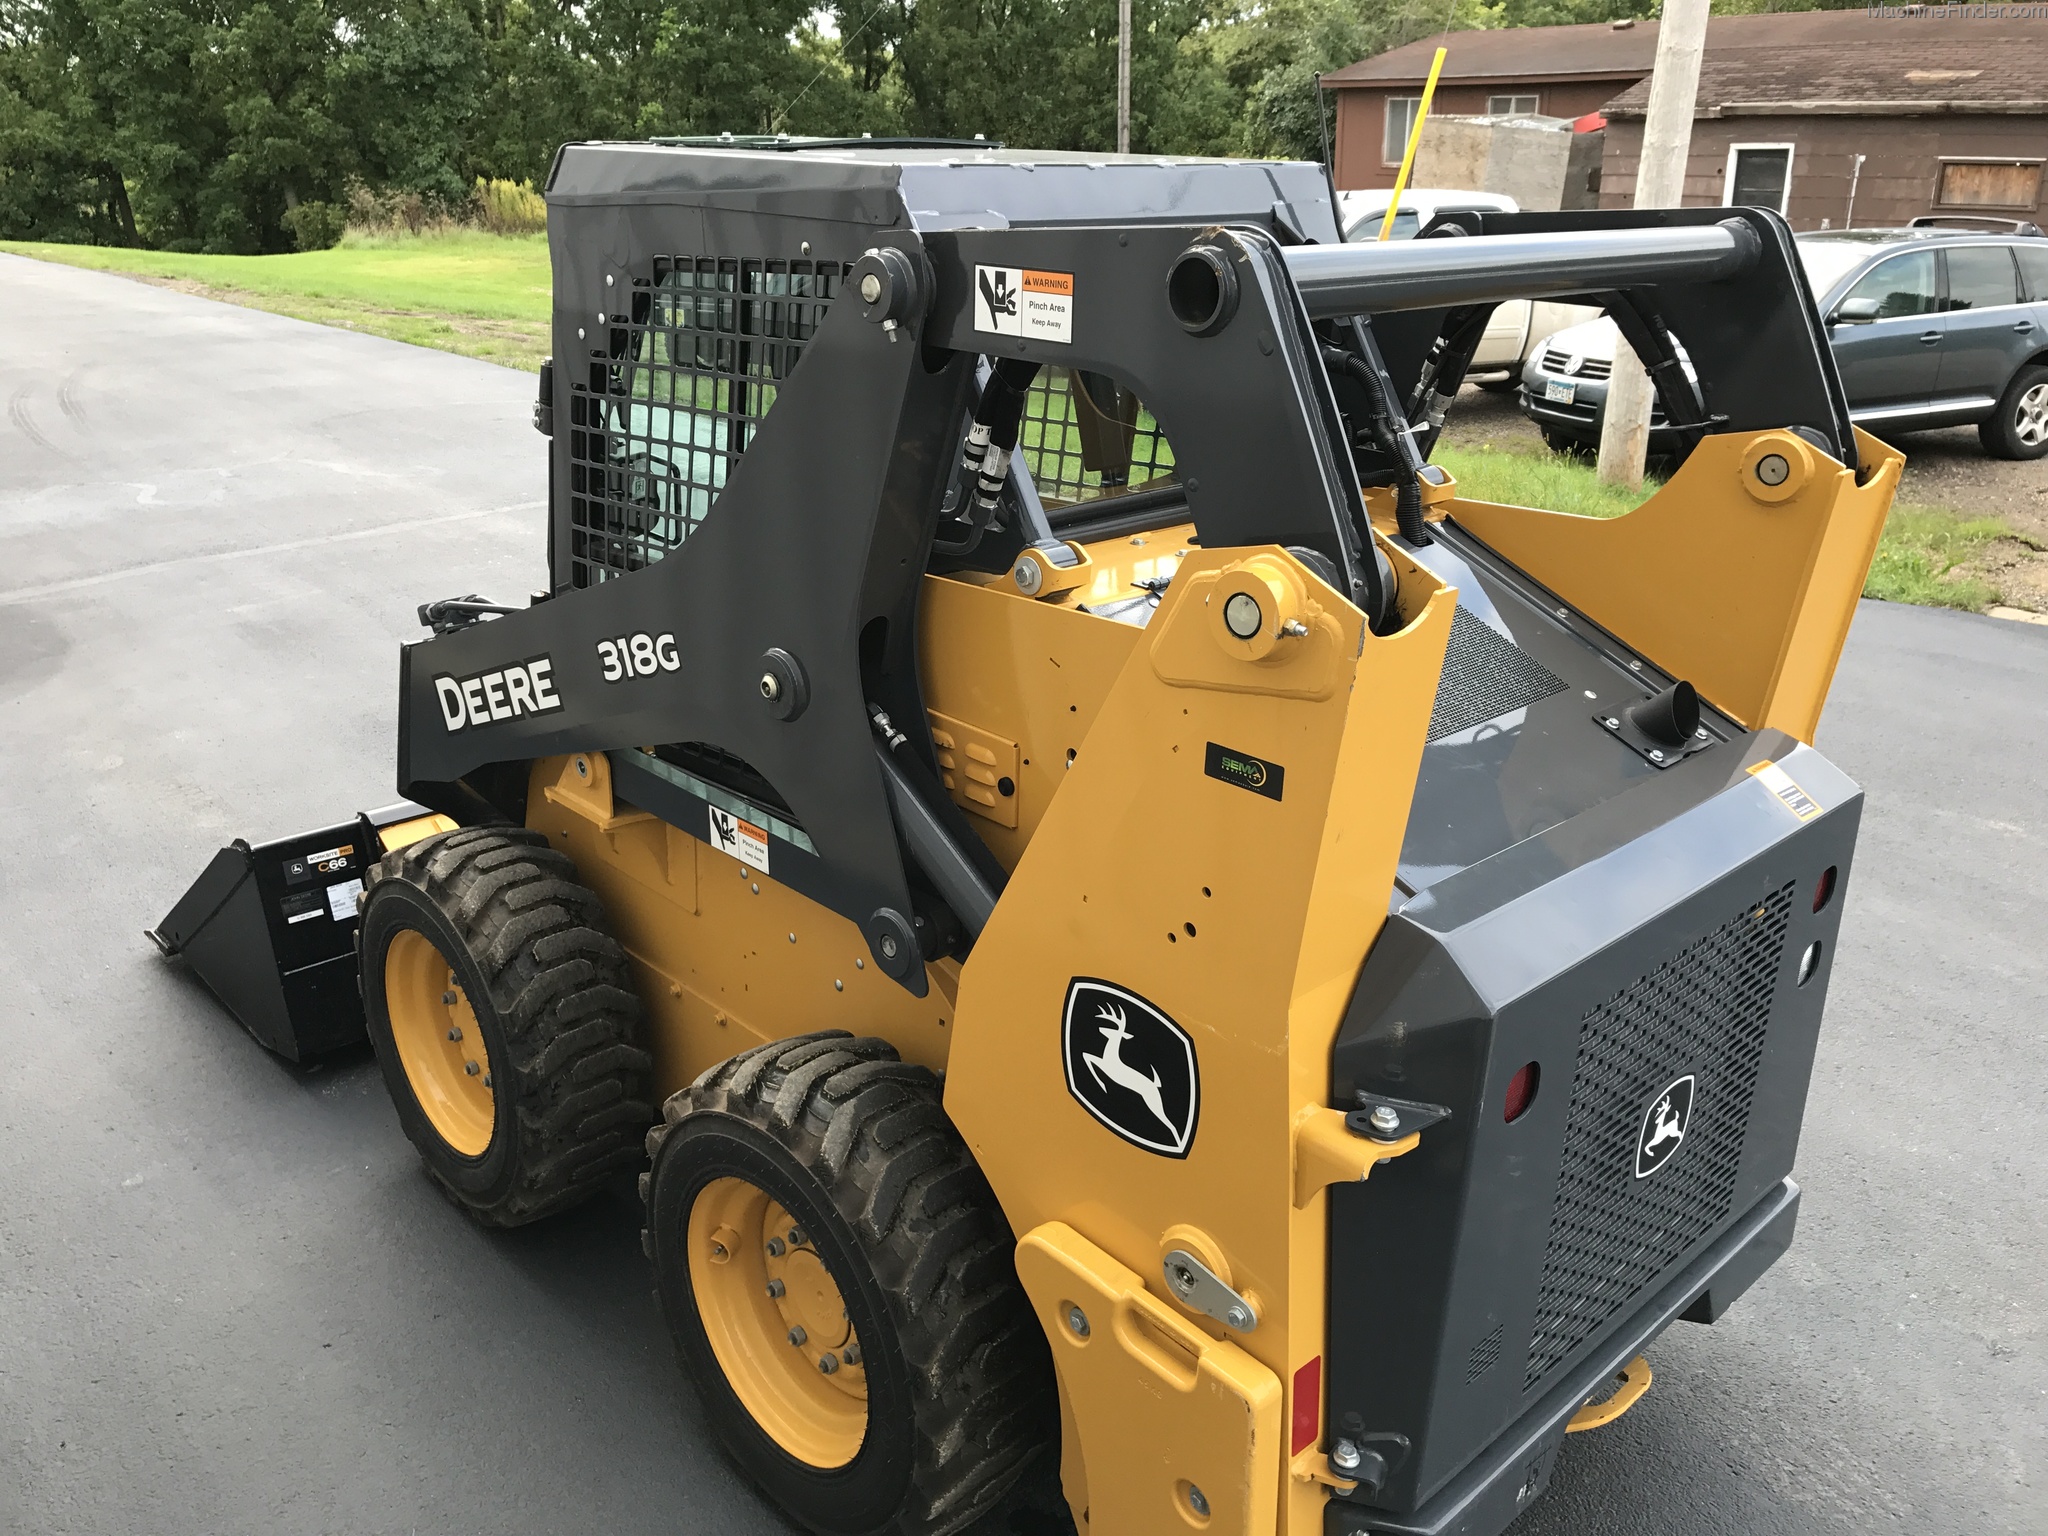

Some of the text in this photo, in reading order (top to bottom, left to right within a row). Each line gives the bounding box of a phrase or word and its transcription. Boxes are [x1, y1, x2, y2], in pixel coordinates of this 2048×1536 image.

[1033, 278, 1068, 289] WARNING
[1029, 300, 1065, 313] Pinch Area
[1031, 317, 1061, 329] Keep Away
[597, 633, 681, 681] 318G
[434, 658, 561, 731] DEERE
[308, 846, 353, 862] WORKSITE PRO
[318, 857, 348, 872] C66
